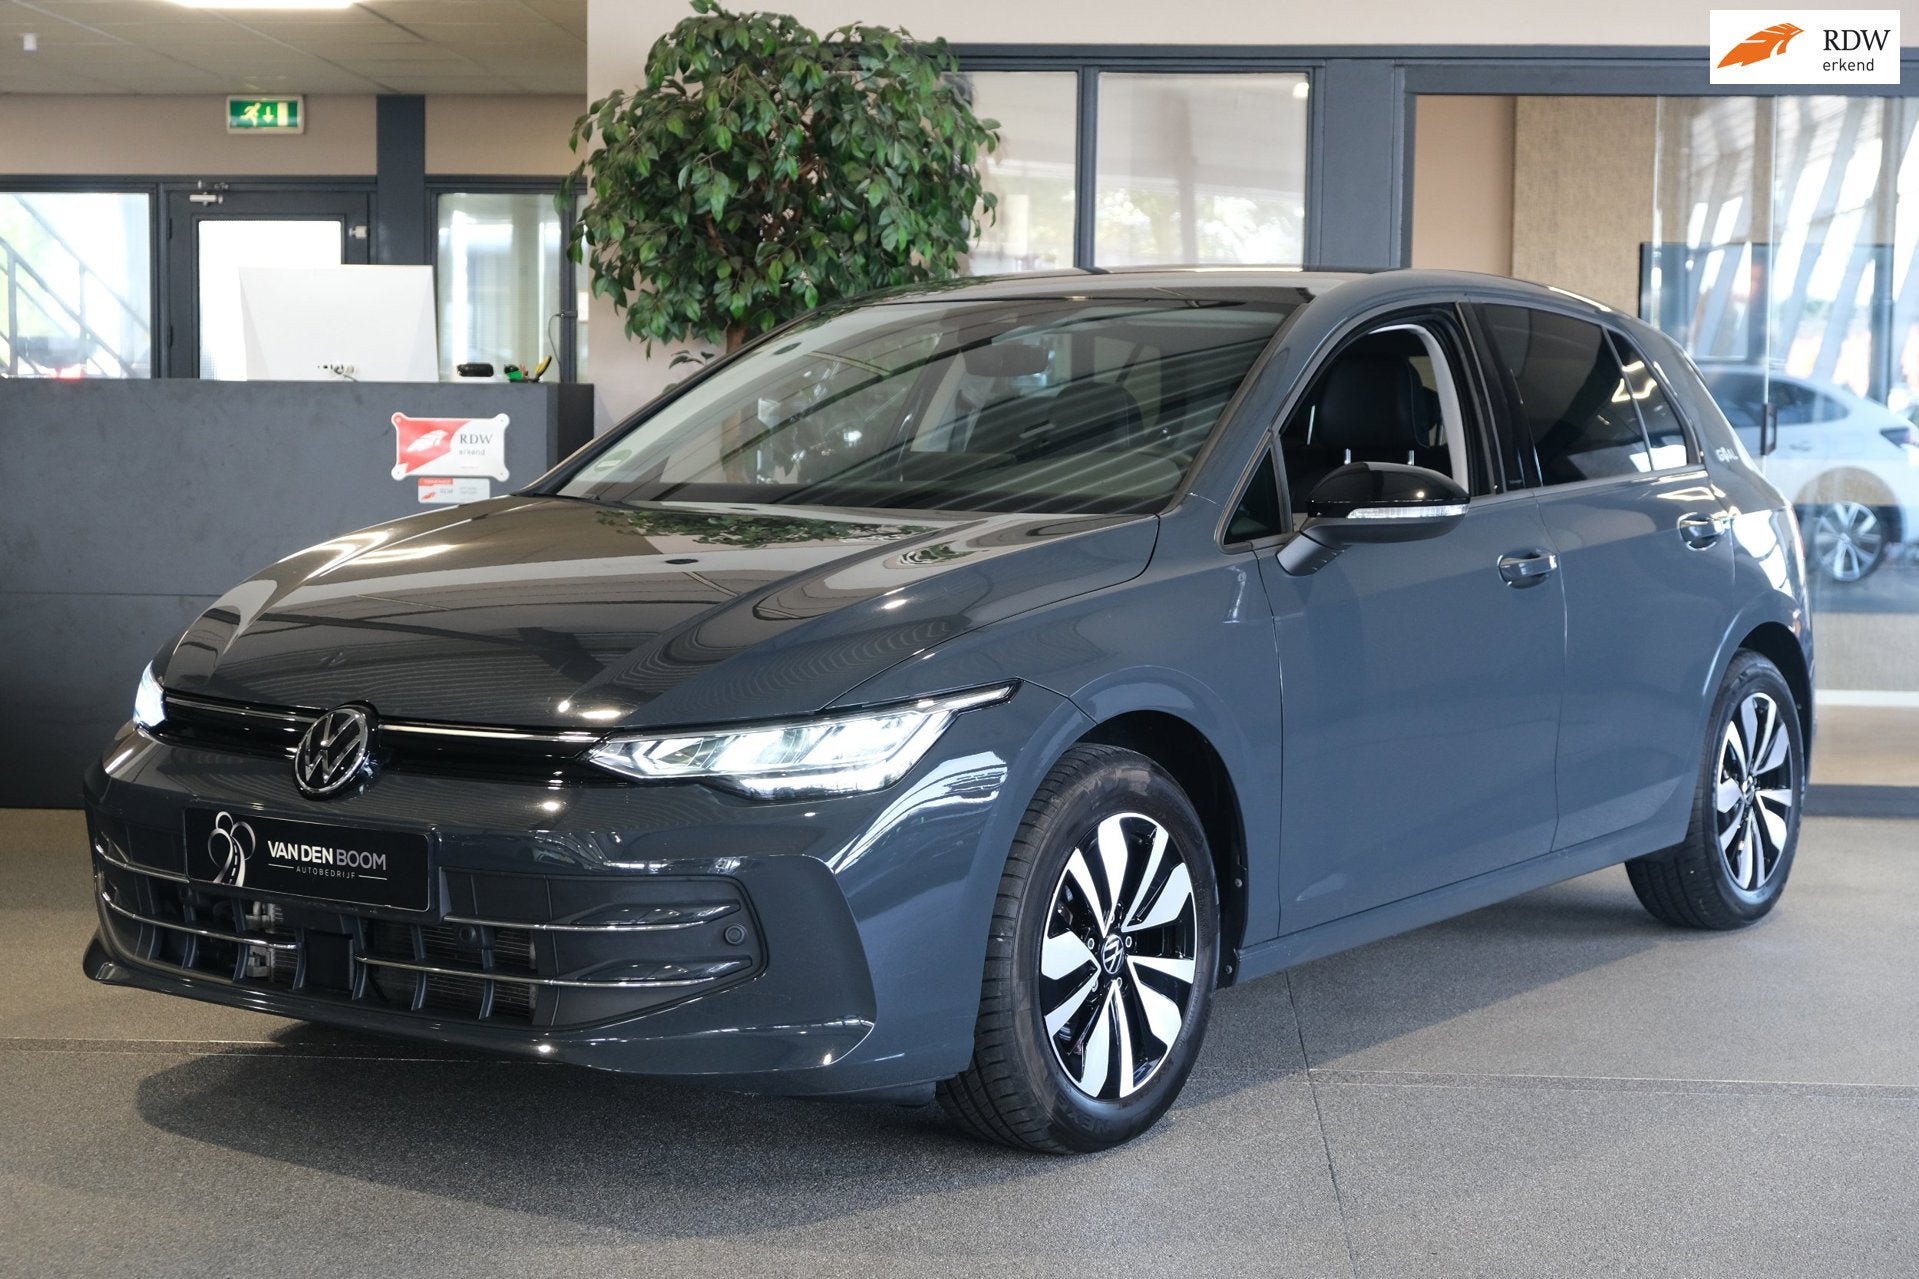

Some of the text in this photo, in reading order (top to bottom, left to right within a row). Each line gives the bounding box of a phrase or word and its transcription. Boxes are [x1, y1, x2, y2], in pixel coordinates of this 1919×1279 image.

[459, 433, 493, 445] RDW
[267, 840, 387, 871] VAN DEN BOOM
[296, 866, 356, 879] AUTOBEDRIJF
